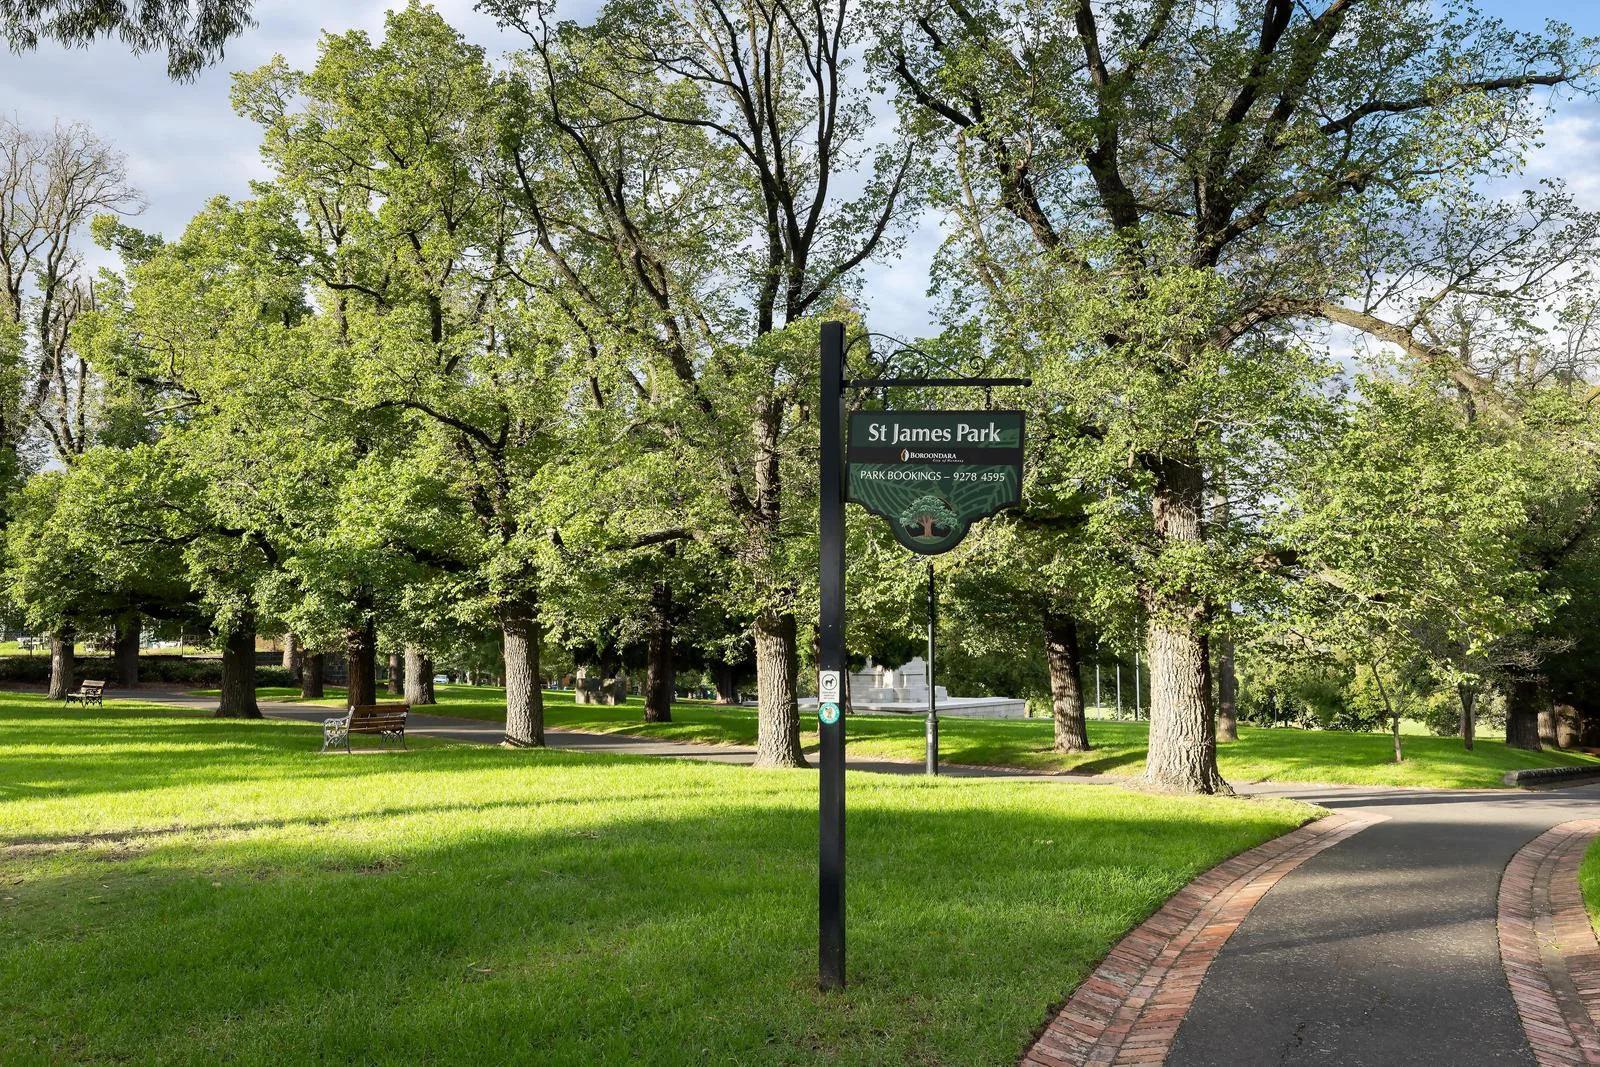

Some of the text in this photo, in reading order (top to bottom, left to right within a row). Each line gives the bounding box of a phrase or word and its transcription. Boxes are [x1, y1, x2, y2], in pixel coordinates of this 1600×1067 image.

[868, 421, 1001, 445] St James Park
[860, 470, 886, 480] PARK
[887, 470, 942, 481] BOOKINGS
[953, 472, 977, 481] 9278
[981, 472, 1005, 482] 4595
